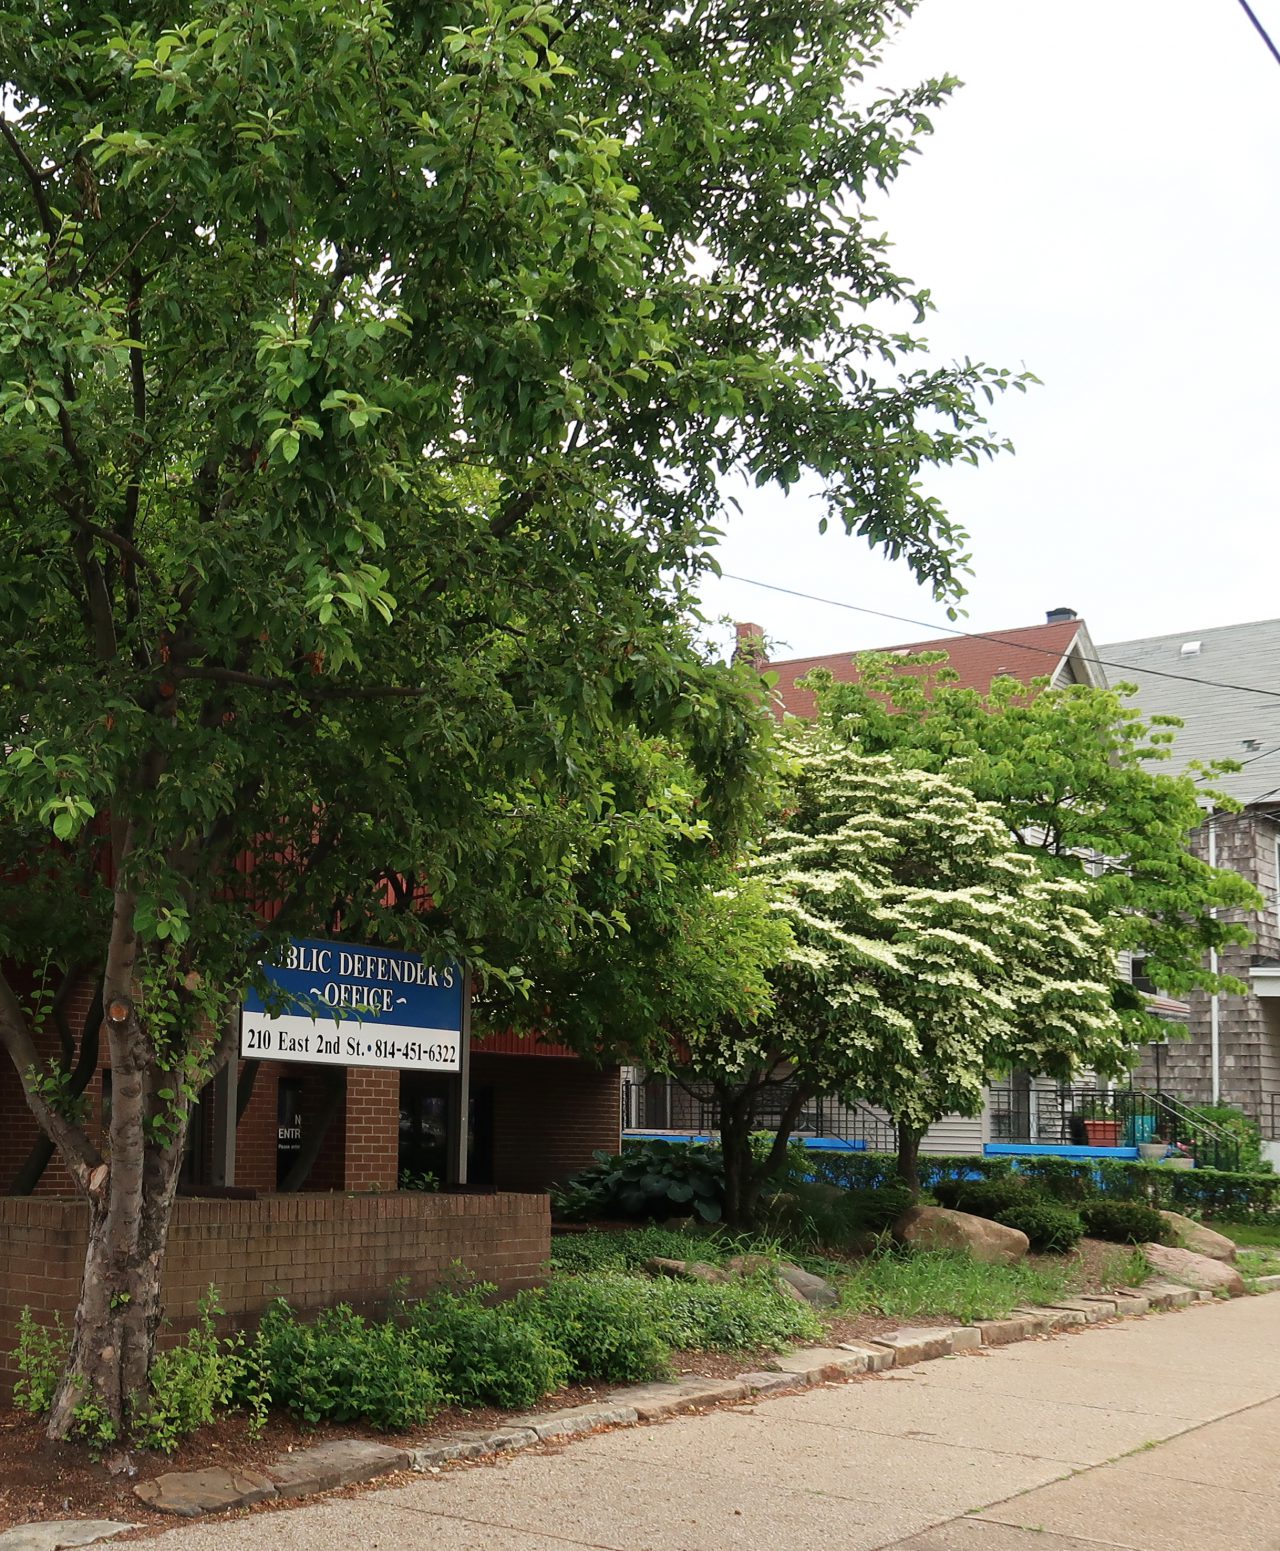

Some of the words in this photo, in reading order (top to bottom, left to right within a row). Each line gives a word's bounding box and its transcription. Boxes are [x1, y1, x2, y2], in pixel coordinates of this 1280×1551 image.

[257, 945, 332, 974] BLIC
[339, 952, 454, 989] DEFENDERS
[247, 1028, 271, 1050] 210
[278, 1031, 309, 1052] East
[316, 1034, 340, 1055] 2nd
[374, 1039, 456, 1063] 814-451-6322
[294, 1114, 301, 1125] N
[278, 1128, 301, 1139] ENTR
